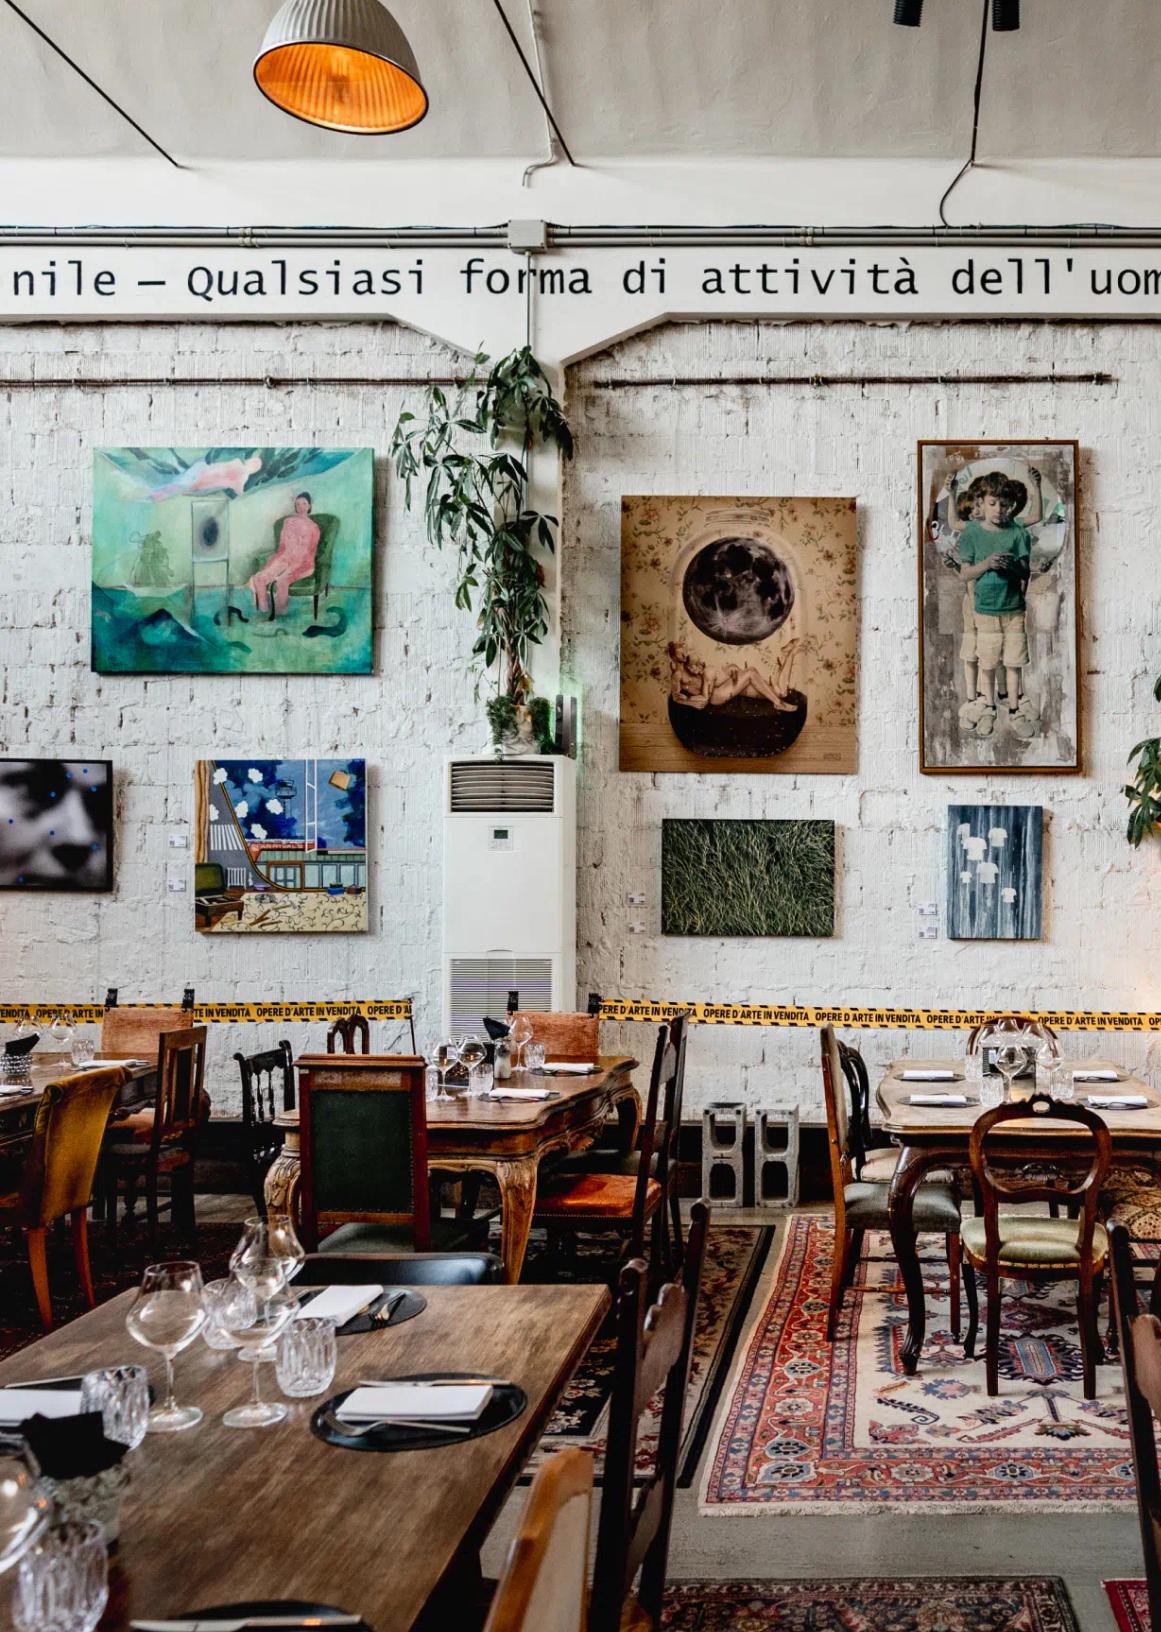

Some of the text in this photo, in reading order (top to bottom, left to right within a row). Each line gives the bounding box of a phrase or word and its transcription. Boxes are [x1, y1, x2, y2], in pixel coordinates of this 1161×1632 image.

[12, 261, 117, 298] nile
[188, 259, 426, 301] Qualsiasi
[461, 258, 591, 294] forma
[623, 258, 667, 295] di
[701, 256, 918, 297] attività
[0, 1009, 29, 1018] ENDITA
[95, 1009, 103, 1017] IN
[205, 1008, 214, 1017] IN
[215, 1008, 250, 1017] VENDITA
[257, 1008, 284, 1017] OPERE
[316, 1007, 324, 1016] IN
[326, 1006, 361, 1015] VENDITA
[368, 1006, 394, 1015] OPERE
[599, 1004, 618, 1014] PERE
[652, 1006, 660, 1015] IN
[704, 1008, 730, 1018] OPERE
[764, 1010, 772, 1019] IN
[774, 1010, 809, 1020] VENDITA
[815, 1012, 843, 1021] OPERE
[875, 1013, 884, 1022] IN
[884, 1014, 921, 1023] VENDITA
[927, 1015, 954, 1024] OPERE
[1038, 1016, 1064, 1025] OPERE
[1098, 1017, 1106, 1025] IN
[1108, 1017, 1143, 1026] VENDITA
